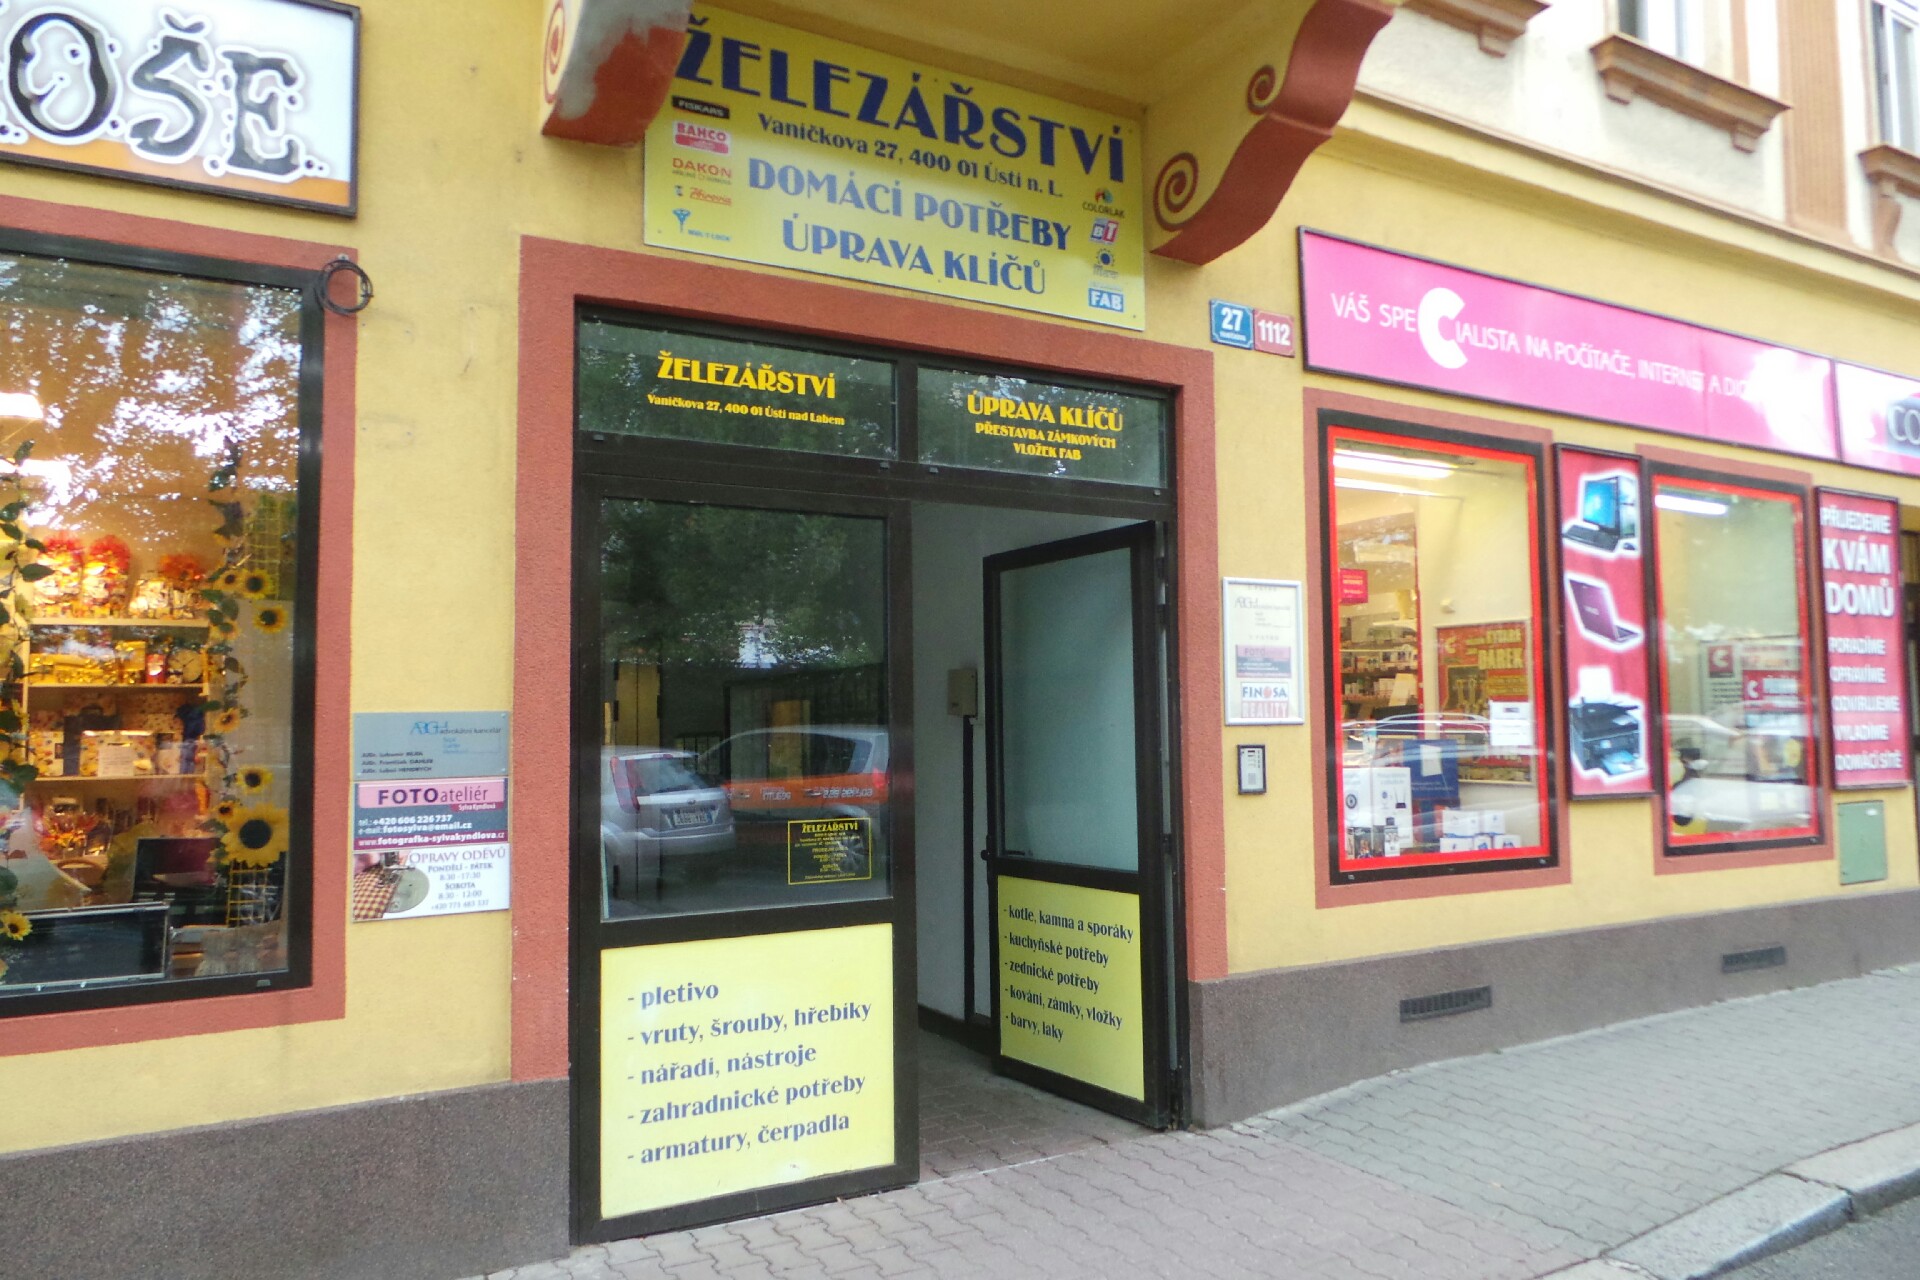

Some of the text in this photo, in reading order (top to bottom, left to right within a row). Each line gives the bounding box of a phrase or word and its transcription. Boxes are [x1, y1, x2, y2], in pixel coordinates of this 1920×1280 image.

[674, 13, 1124, 183] ŽELEZÁŘSTVÍ
[676, 122, 727, 142] BAHCO
[672, 157, 732, 178] DAKON
[909, 149, 950, 172] 400
[957, 159, 978, 178] 01
[1027, 178, 1043, 192] n.
[1049, 180, 1063, 197] L.
[749, 157, 1071, 250] DOMÁCÍ POTŘEBY
[1082, 201, 1125, 218] COLORLAK
[783, 213, 1046, 295] ÚPRAVA KLÍČŮ
[1089, 289, 1123, 311] FAB
[1221, 307, 1244, 331] 27
[1258, 319, 1291, 346] 1112
[1330, 292, 1371, 323] VÁŠ
[1379, 287, 1520, 369] SPECIALISTA
[1526, 335, 1552, 361] NA
[1554, 342, 1636, 379] POČÍTAČE,
[1638, 360, 1705, 393] INTERNET
[1708, 376, 1719, 393] A
[657, 350, 836, 399] ŽELEZÁŘSTVÍ
[706, 402, 723, 413] 27,
[724, 403, 749, 415] 400
[750, 407, 763, 416] 01
[788, 411, 809, 421] nad
[810, 412, 845, 426] Labem
[967, 389, 1124, 432] ÚPRAVA KLÍČŮ
[975, 421, 1116, 449] PŘESTAVBA ZÁMKOVÝCH
[1013, 442, 1082, 461] VLOŽEK FAB
[1822, 535, 1891, 574] K VÁM
[1824, 578, 1894, 617] DOMŮ
[1242, 701, 1289, 718] REALITY
[373, 817, 397, 826] +420
[397, 816, 416, 825] 606
[417, 815, 435, 824] 226
[435, 814, 453, 823] 737
[802, 821, 859, 834] ŽELEZÁŘSTVÍ
[409, 846, 506, 864] OPRAVY ODĚVŮ
[428, 863, 463, 873] PONDĚLÍ
[470, 862, 493, 870] PÁTEK
[445, 882, 475, 890] SOBOTA
[1009, 905, 1037, 925] kotle,
[1039, 910, 1074, 930] kamna
[1077, 920, 1084, 931] a
[1087, 921, 1133, 943] sporáky
[1009, 932, 1063, 956] kuchyňské
[1065, 945, 1109, 968] potřeby
[1009, 960, 1054, 981] zednické
[1057, 971, 1100, 995] potřeby
[641, 982, 719, 1010] pletivo
[1010, 985, 1045, 1009] kování,
[1047, 996, 1084, 1020] zámky,
[1086, 1007, 1122, 1031] vložky
[640, 1022, 704, 1046] vruty,
[710, 1013, 788, 1037] šrouby,
[794, 1002, 872, 1026] hřebíky
[1010, 1012, 1040, 1036] barvy,
[1042, 1021, 1064, 1043] laky
[640, 1057, 720, 1085] nářadí,
[727, 1044, 817, 1073] nástroje
[640, 1086, 779, 1125] zahradnické
[786, 1075, 866, 1105] potřeby
[641, 1131, 751, 1164] armatury,
[757, 1113, 850, 1144] čerpadla
